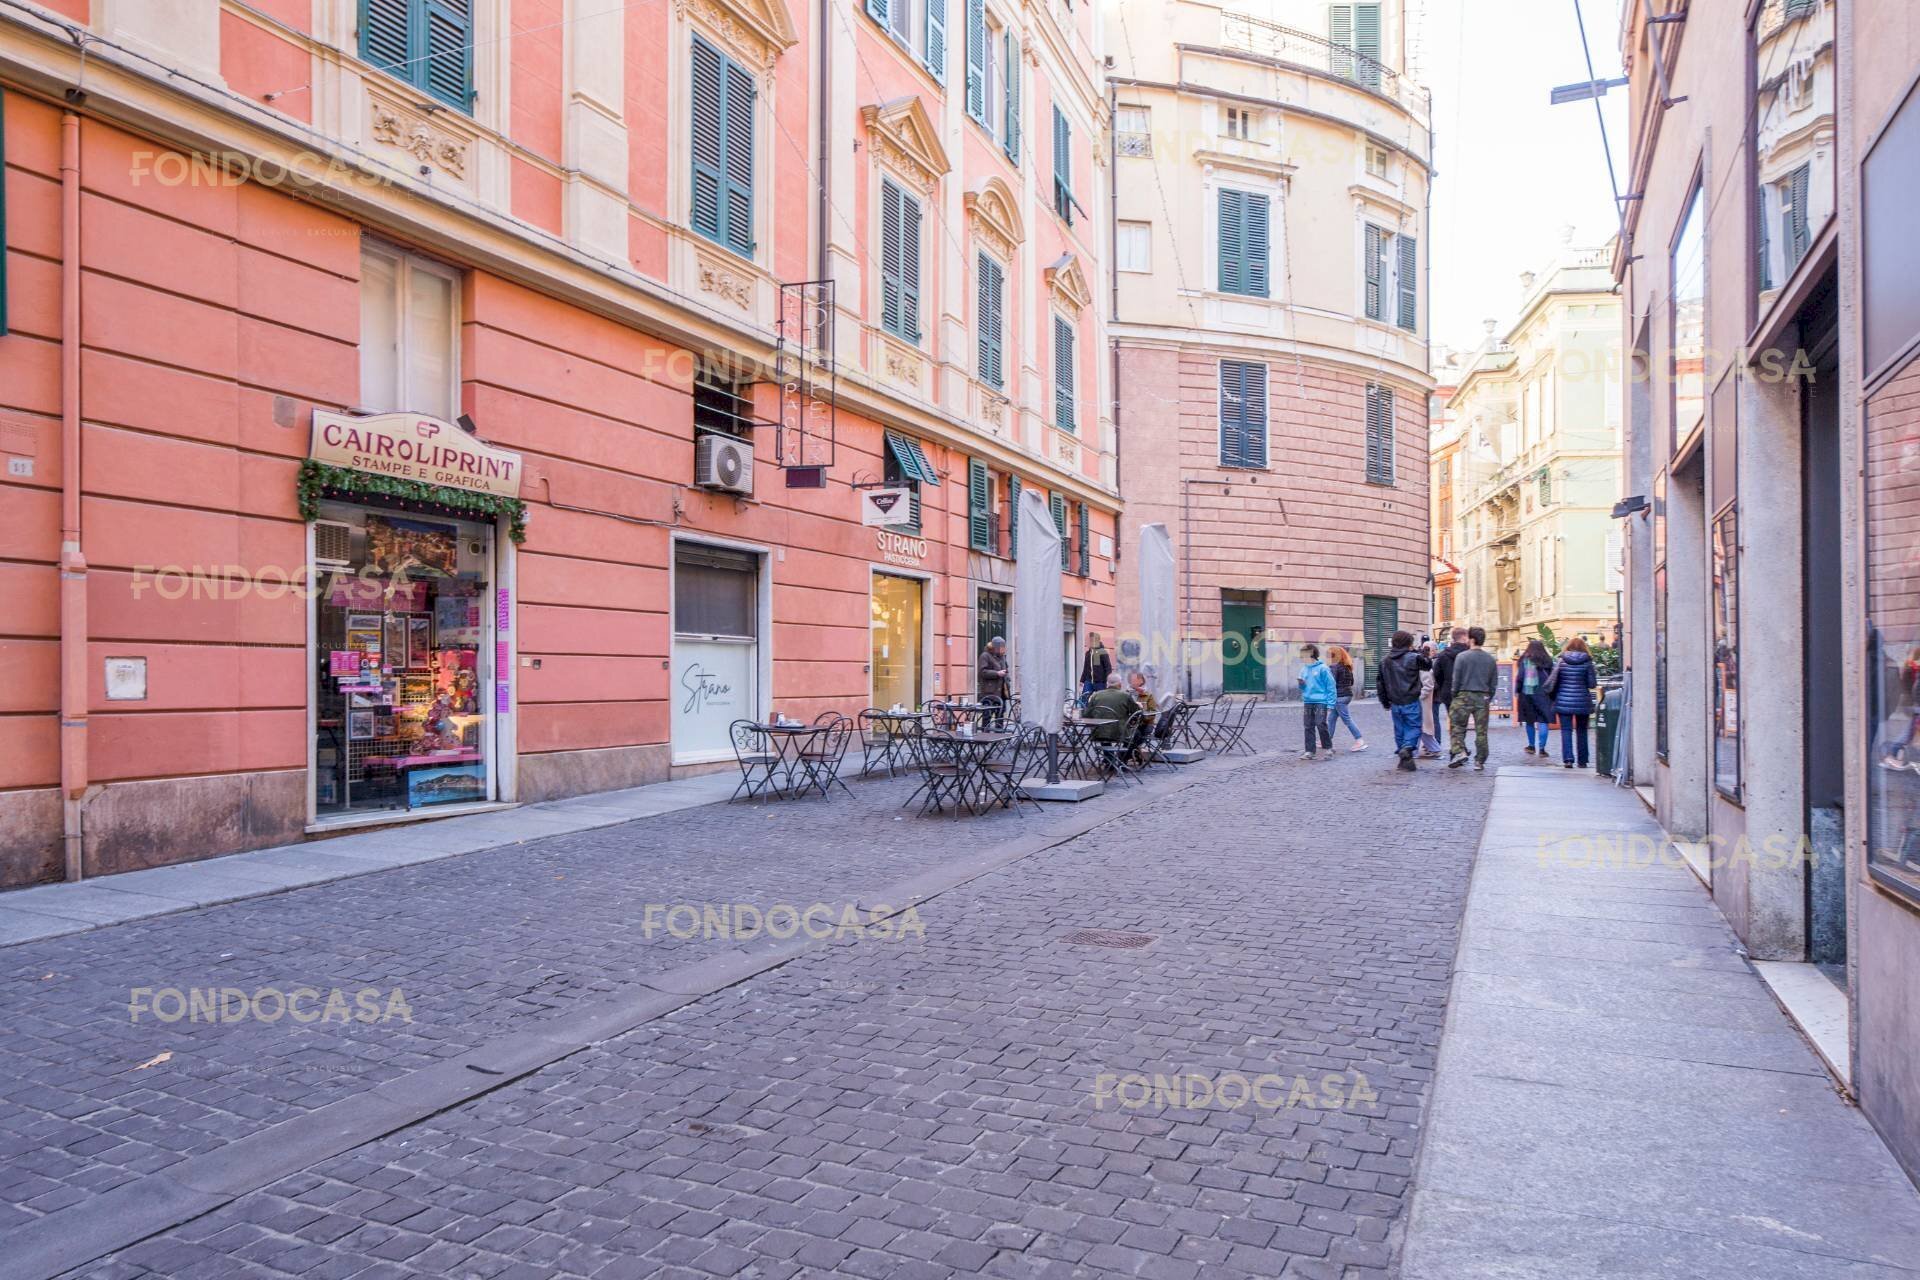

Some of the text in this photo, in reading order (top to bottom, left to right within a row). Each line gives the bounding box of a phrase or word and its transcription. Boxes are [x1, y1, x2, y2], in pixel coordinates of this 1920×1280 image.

[323, 424, 514, 481] CAIROLIPRINT
[352, 455, 491, 490] STAMPE E GRAFICA
[876, 531, 928, 559] STRANO
[681, 663, 731, 715] Strano
